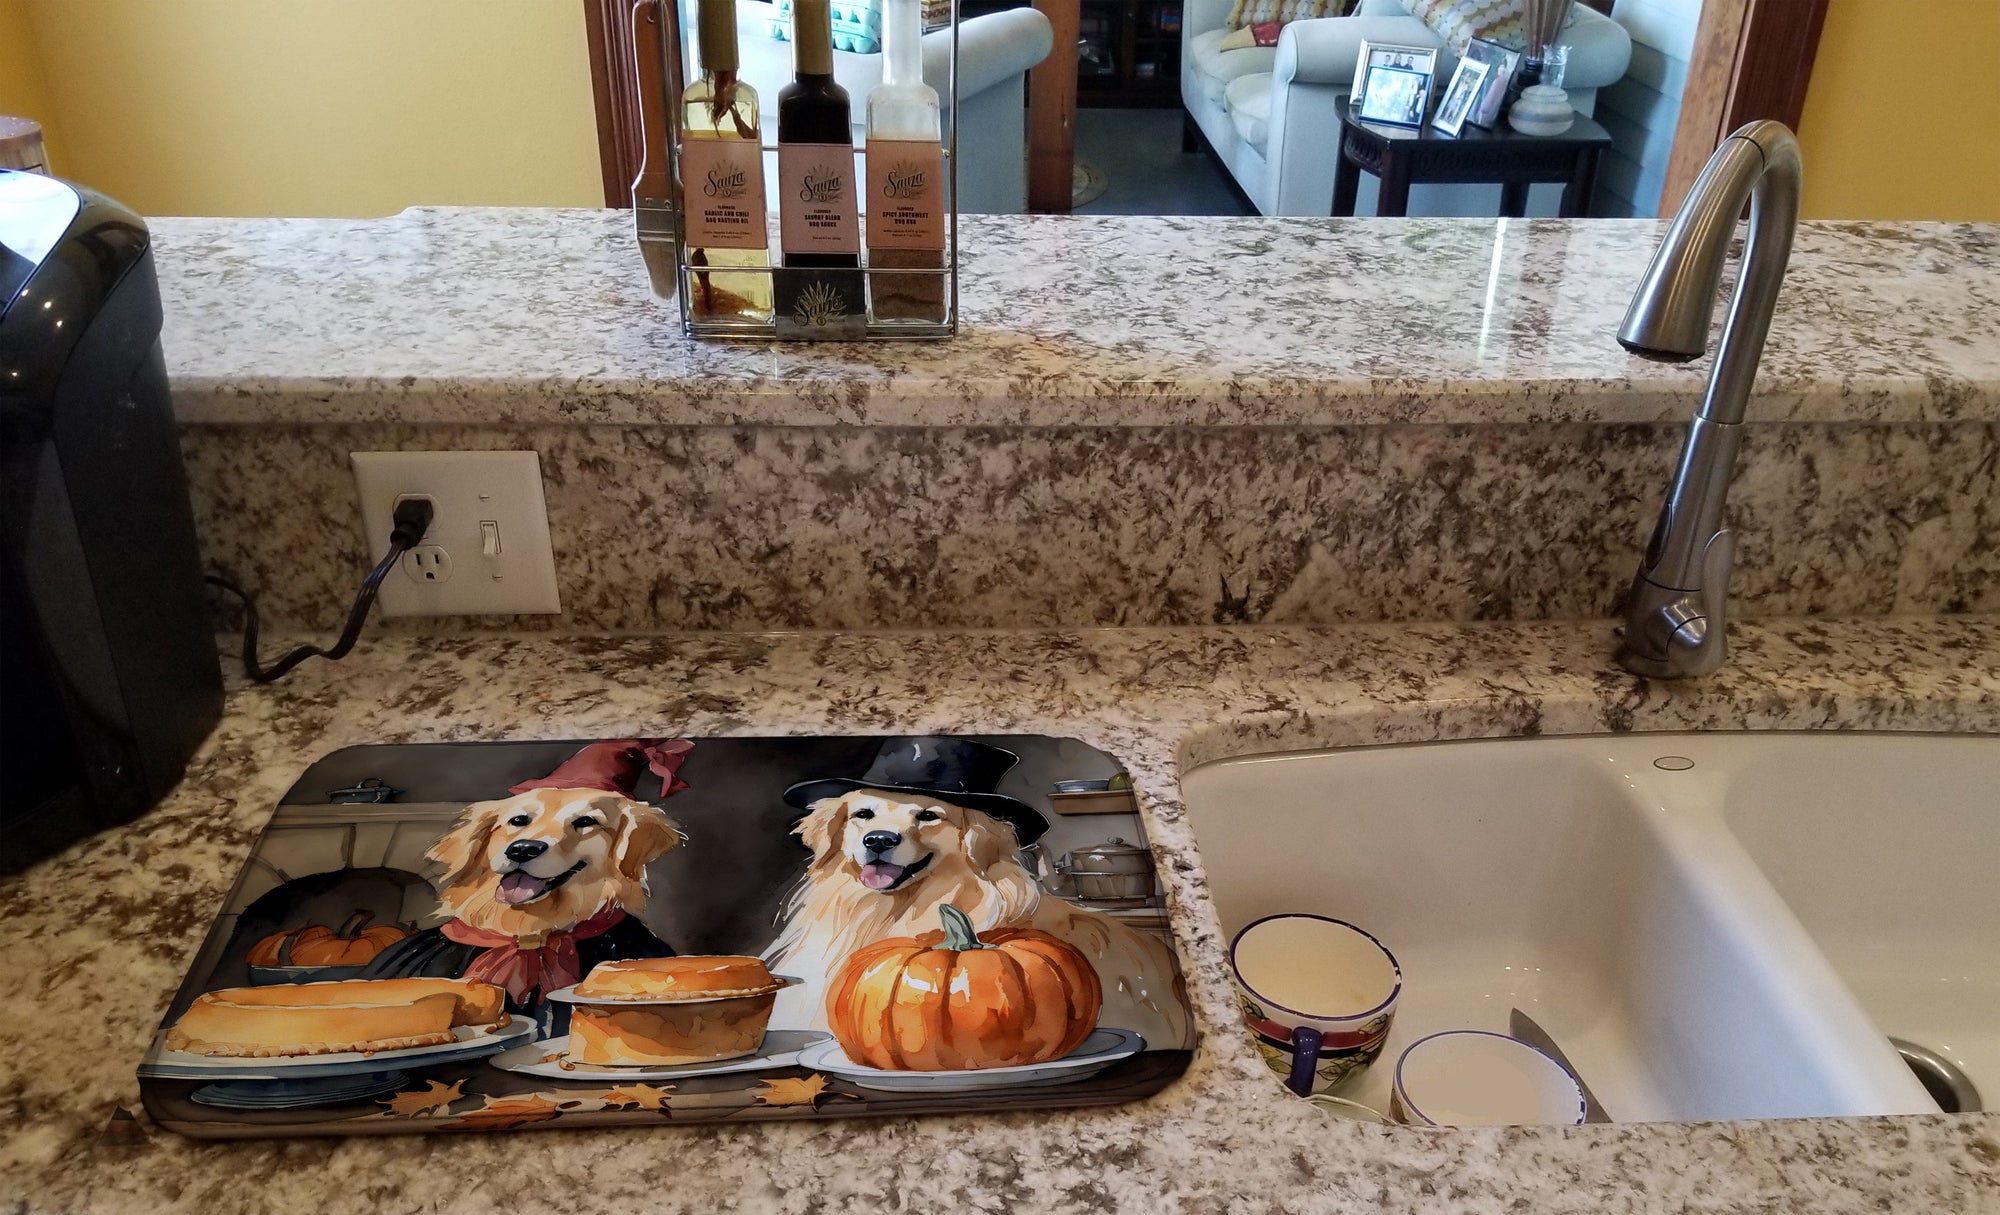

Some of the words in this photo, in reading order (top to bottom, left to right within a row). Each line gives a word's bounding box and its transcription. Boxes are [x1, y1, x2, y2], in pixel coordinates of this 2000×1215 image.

[704, 169, 745, 197] Sauza
[800, 175, 842, 202] Sauza
[884, 171, 924, 198] Sauza
